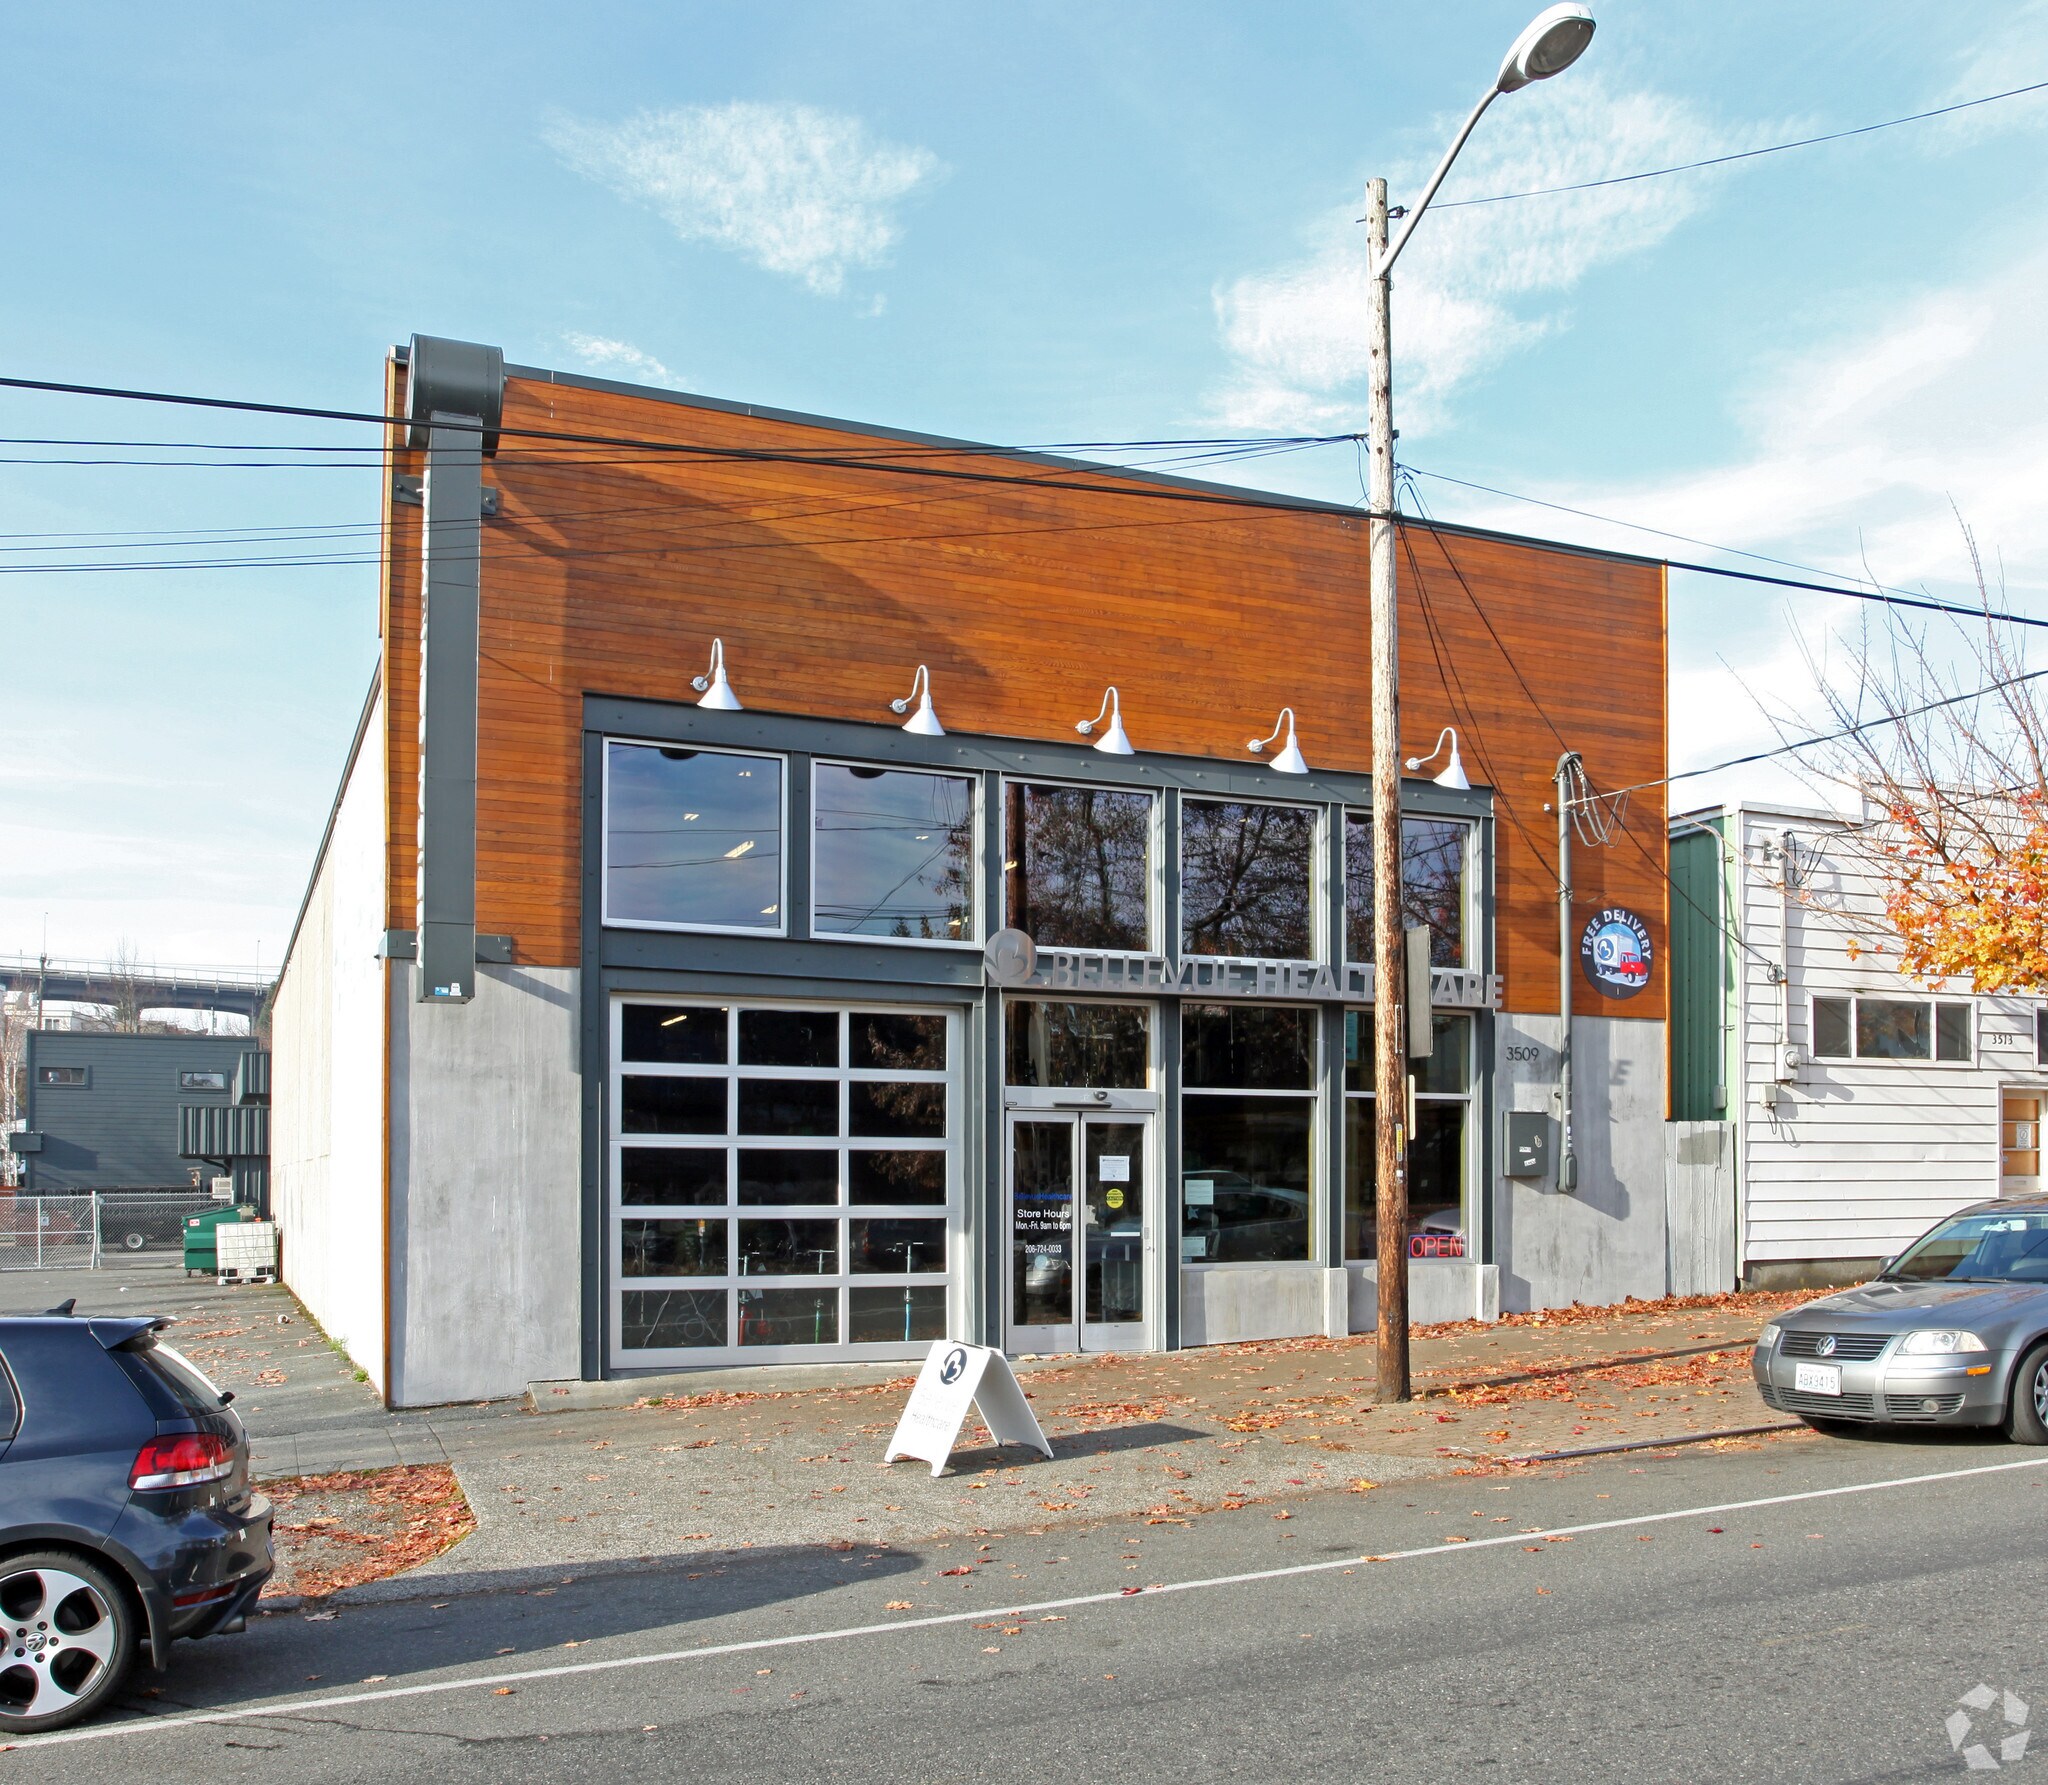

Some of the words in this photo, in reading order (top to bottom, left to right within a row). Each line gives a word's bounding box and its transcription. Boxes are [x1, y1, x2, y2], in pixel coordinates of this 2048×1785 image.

[1582, 918, 1601, 956] FREE
[1603, 909, 1651, 960] DELIVERY
[1053, 951, 1241, 993] BELLEVUE
[1257, 961, 1504, 1007] HEALTARE
[1992, 1034, 2013, 1045] 3513
[1506, 1046, 1539, 1061] 3509
[1017, 1208, 1041, 1218] Store
[1043, 1209, 1070, 1218] Hours
[1040, 1221, 1052, 1230] 9am
[1053, 1221, 1059, 1230] to
[1411, 1236, 1463, 1257] OPEN
